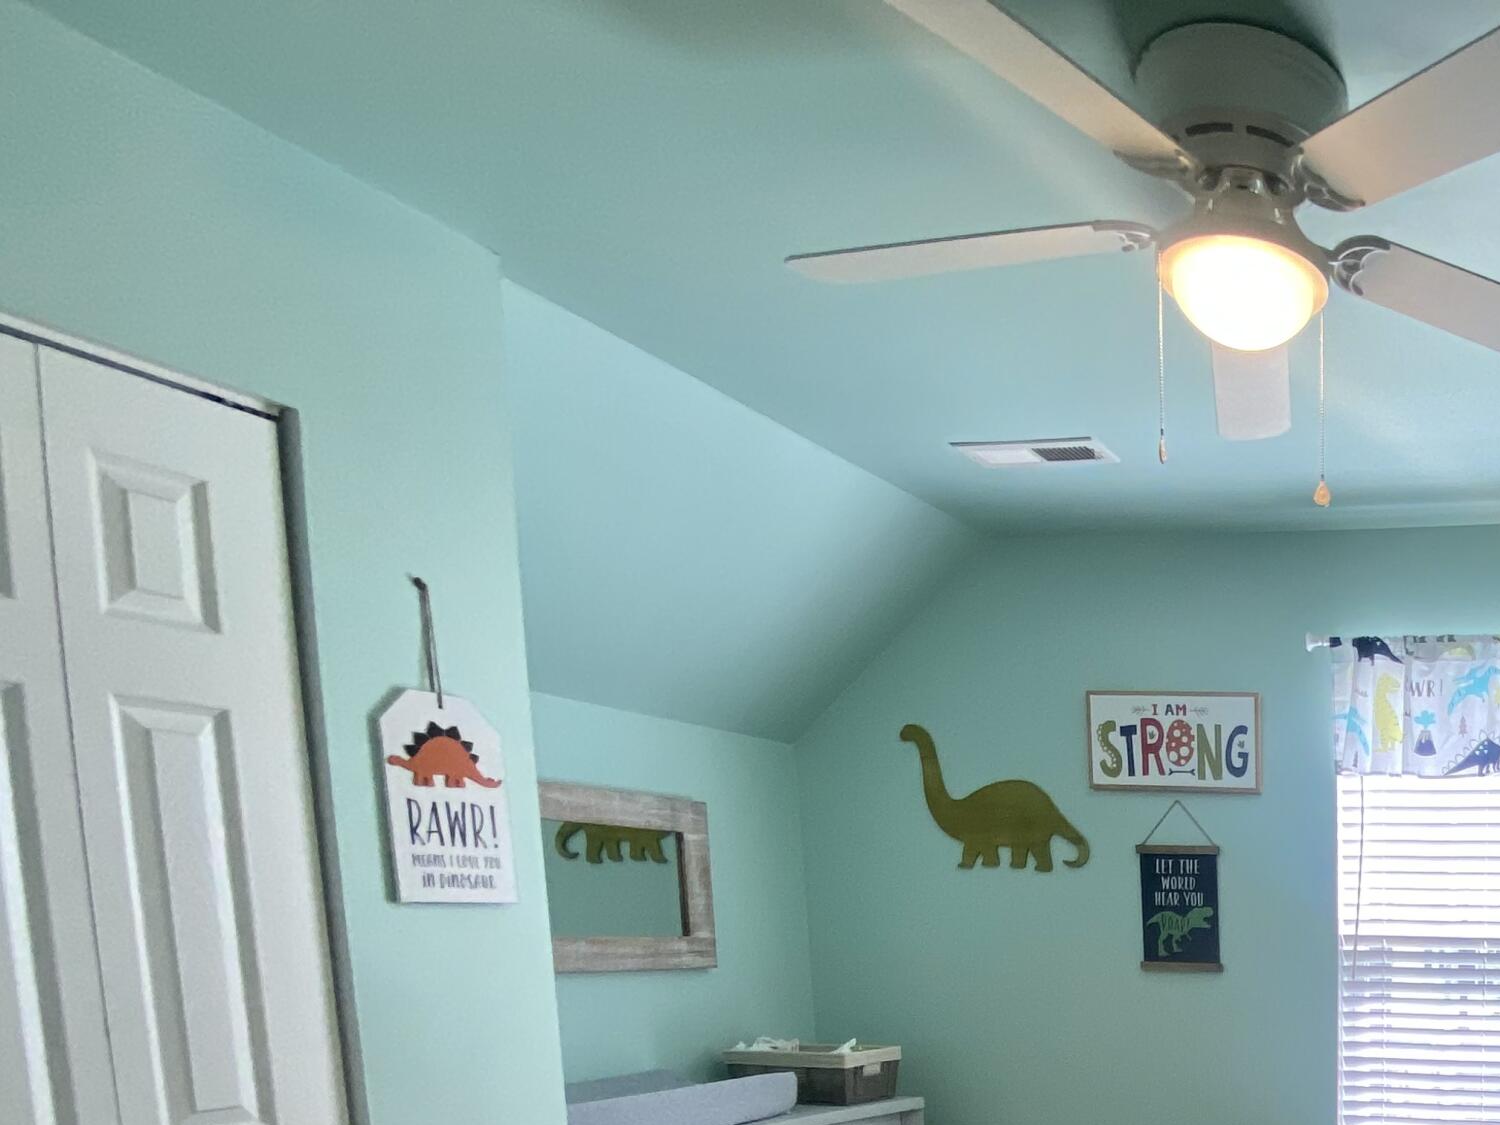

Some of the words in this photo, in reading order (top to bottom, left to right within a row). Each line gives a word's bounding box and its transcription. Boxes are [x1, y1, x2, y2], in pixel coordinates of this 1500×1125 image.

[1152, 704, 1158, 716] I
[1165, 704, 1187, 716] AM
[1097, 717, 1249, 780] STRONG
[406, 798, 499, 849] RAWR!
[1155, 858, 1173, 874] LET
[1180, 859, 1200, 875] THE
[1161, 876, 1196, 890] WORLD
[1154, 891, 1180, 906] HEAR
[1183, 892, 1204, 907] YOU
